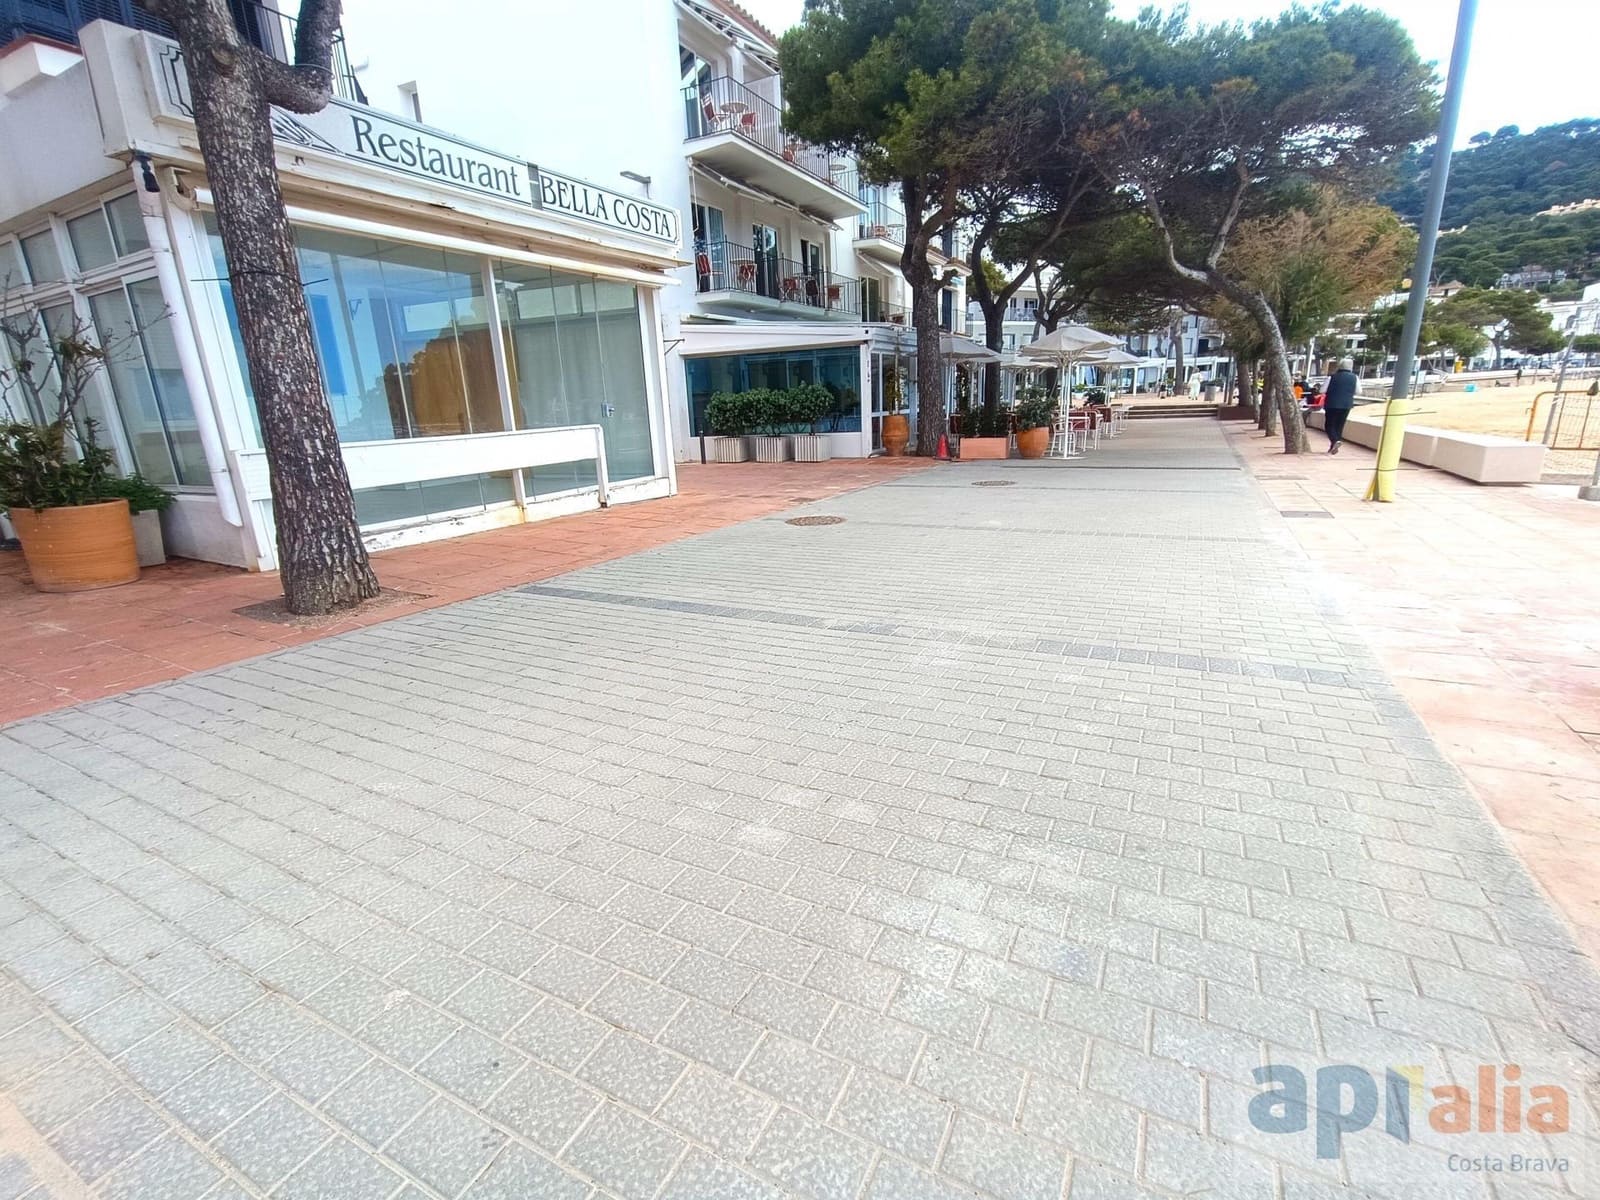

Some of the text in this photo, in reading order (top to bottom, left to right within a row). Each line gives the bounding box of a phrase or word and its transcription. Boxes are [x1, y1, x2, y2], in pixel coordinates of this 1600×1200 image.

[350, 114, 671, 237] Restaurant BELLA COSTA
